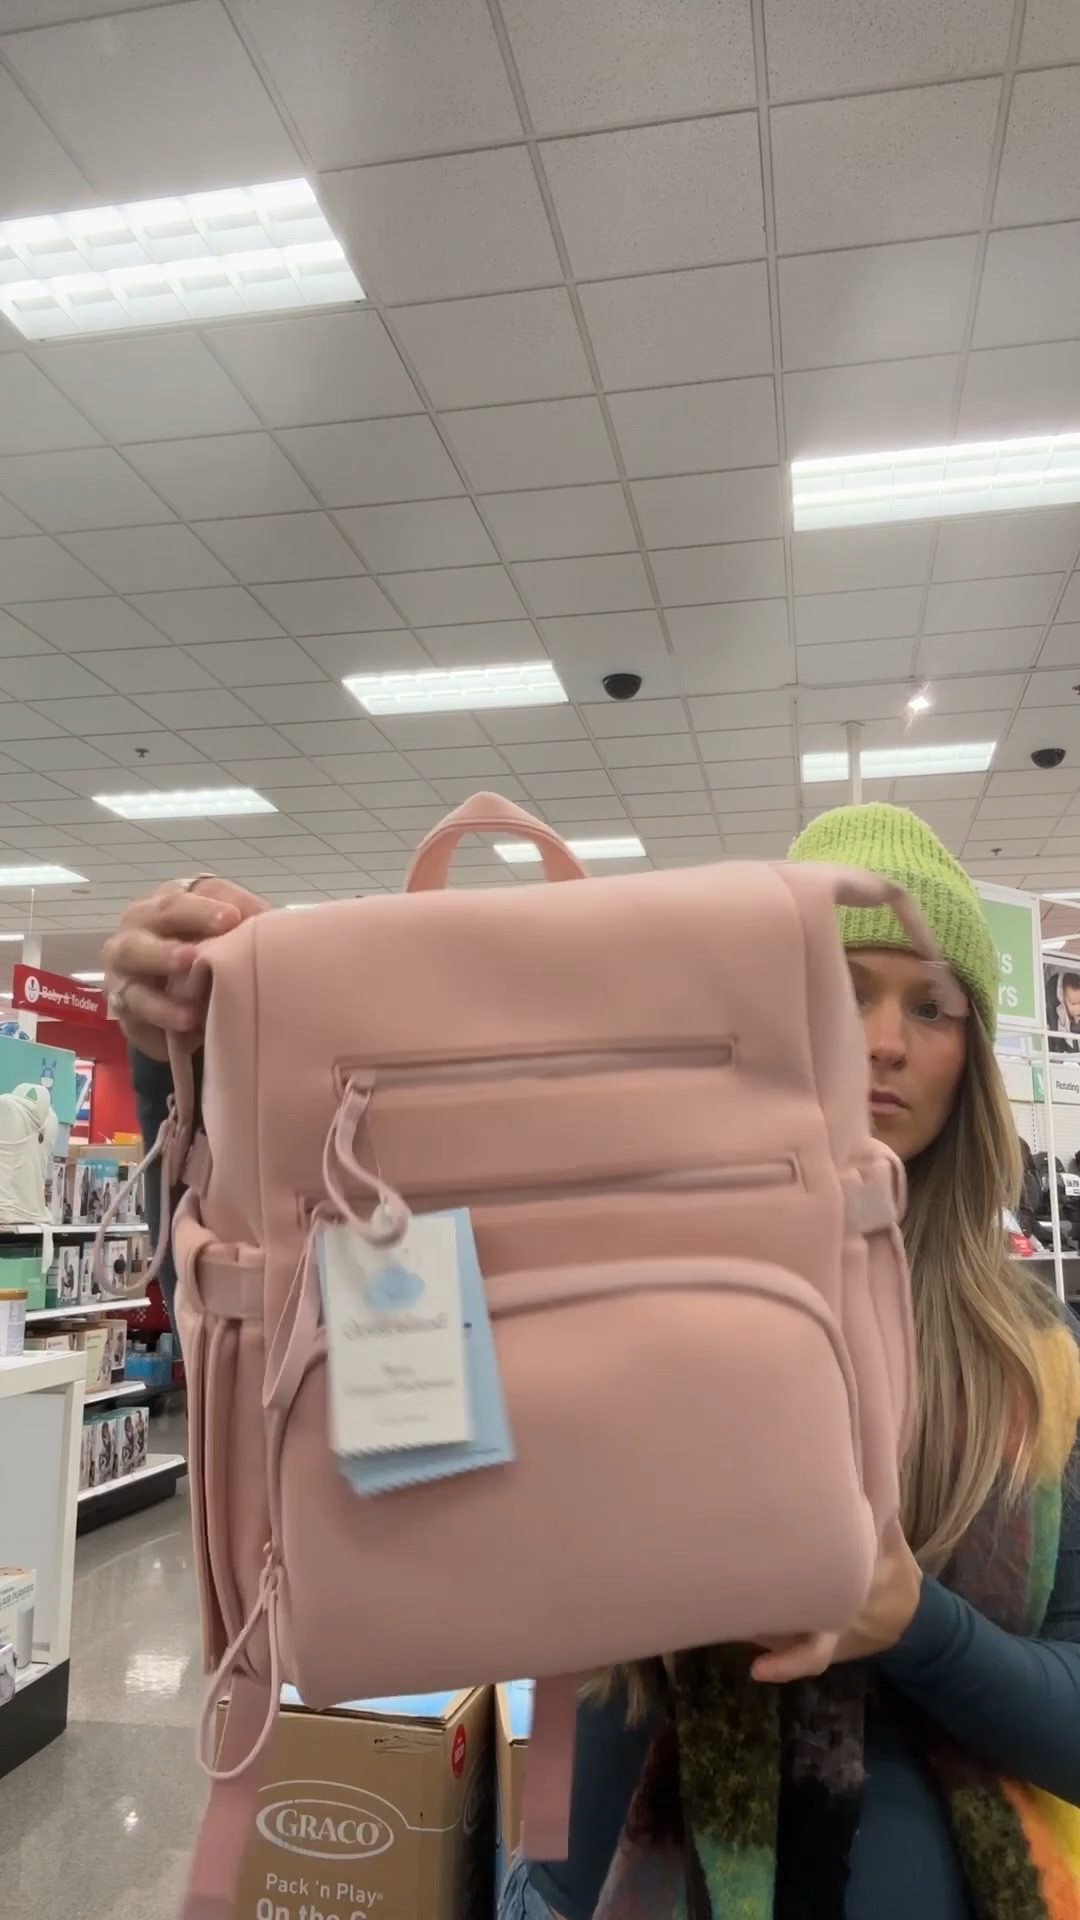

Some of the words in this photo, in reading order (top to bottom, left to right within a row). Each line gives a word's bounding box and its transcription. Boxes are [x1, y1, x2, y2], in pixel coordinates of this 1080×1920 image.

[1001, 953, 1013, 974] s
[41, 985, 61, 1005] Baby
[62, 992, 70, 1004] &
[72, 993, 99, 1012] Toddler
[998, 985, 1018, 1007] rs
[1056, 1080, 1079, 1094] Rotating
[275, 1808, 380, 1846] GRACO
[265, 1873, 309, 1896] Pack
[256, 1898, 290, 1920] On
